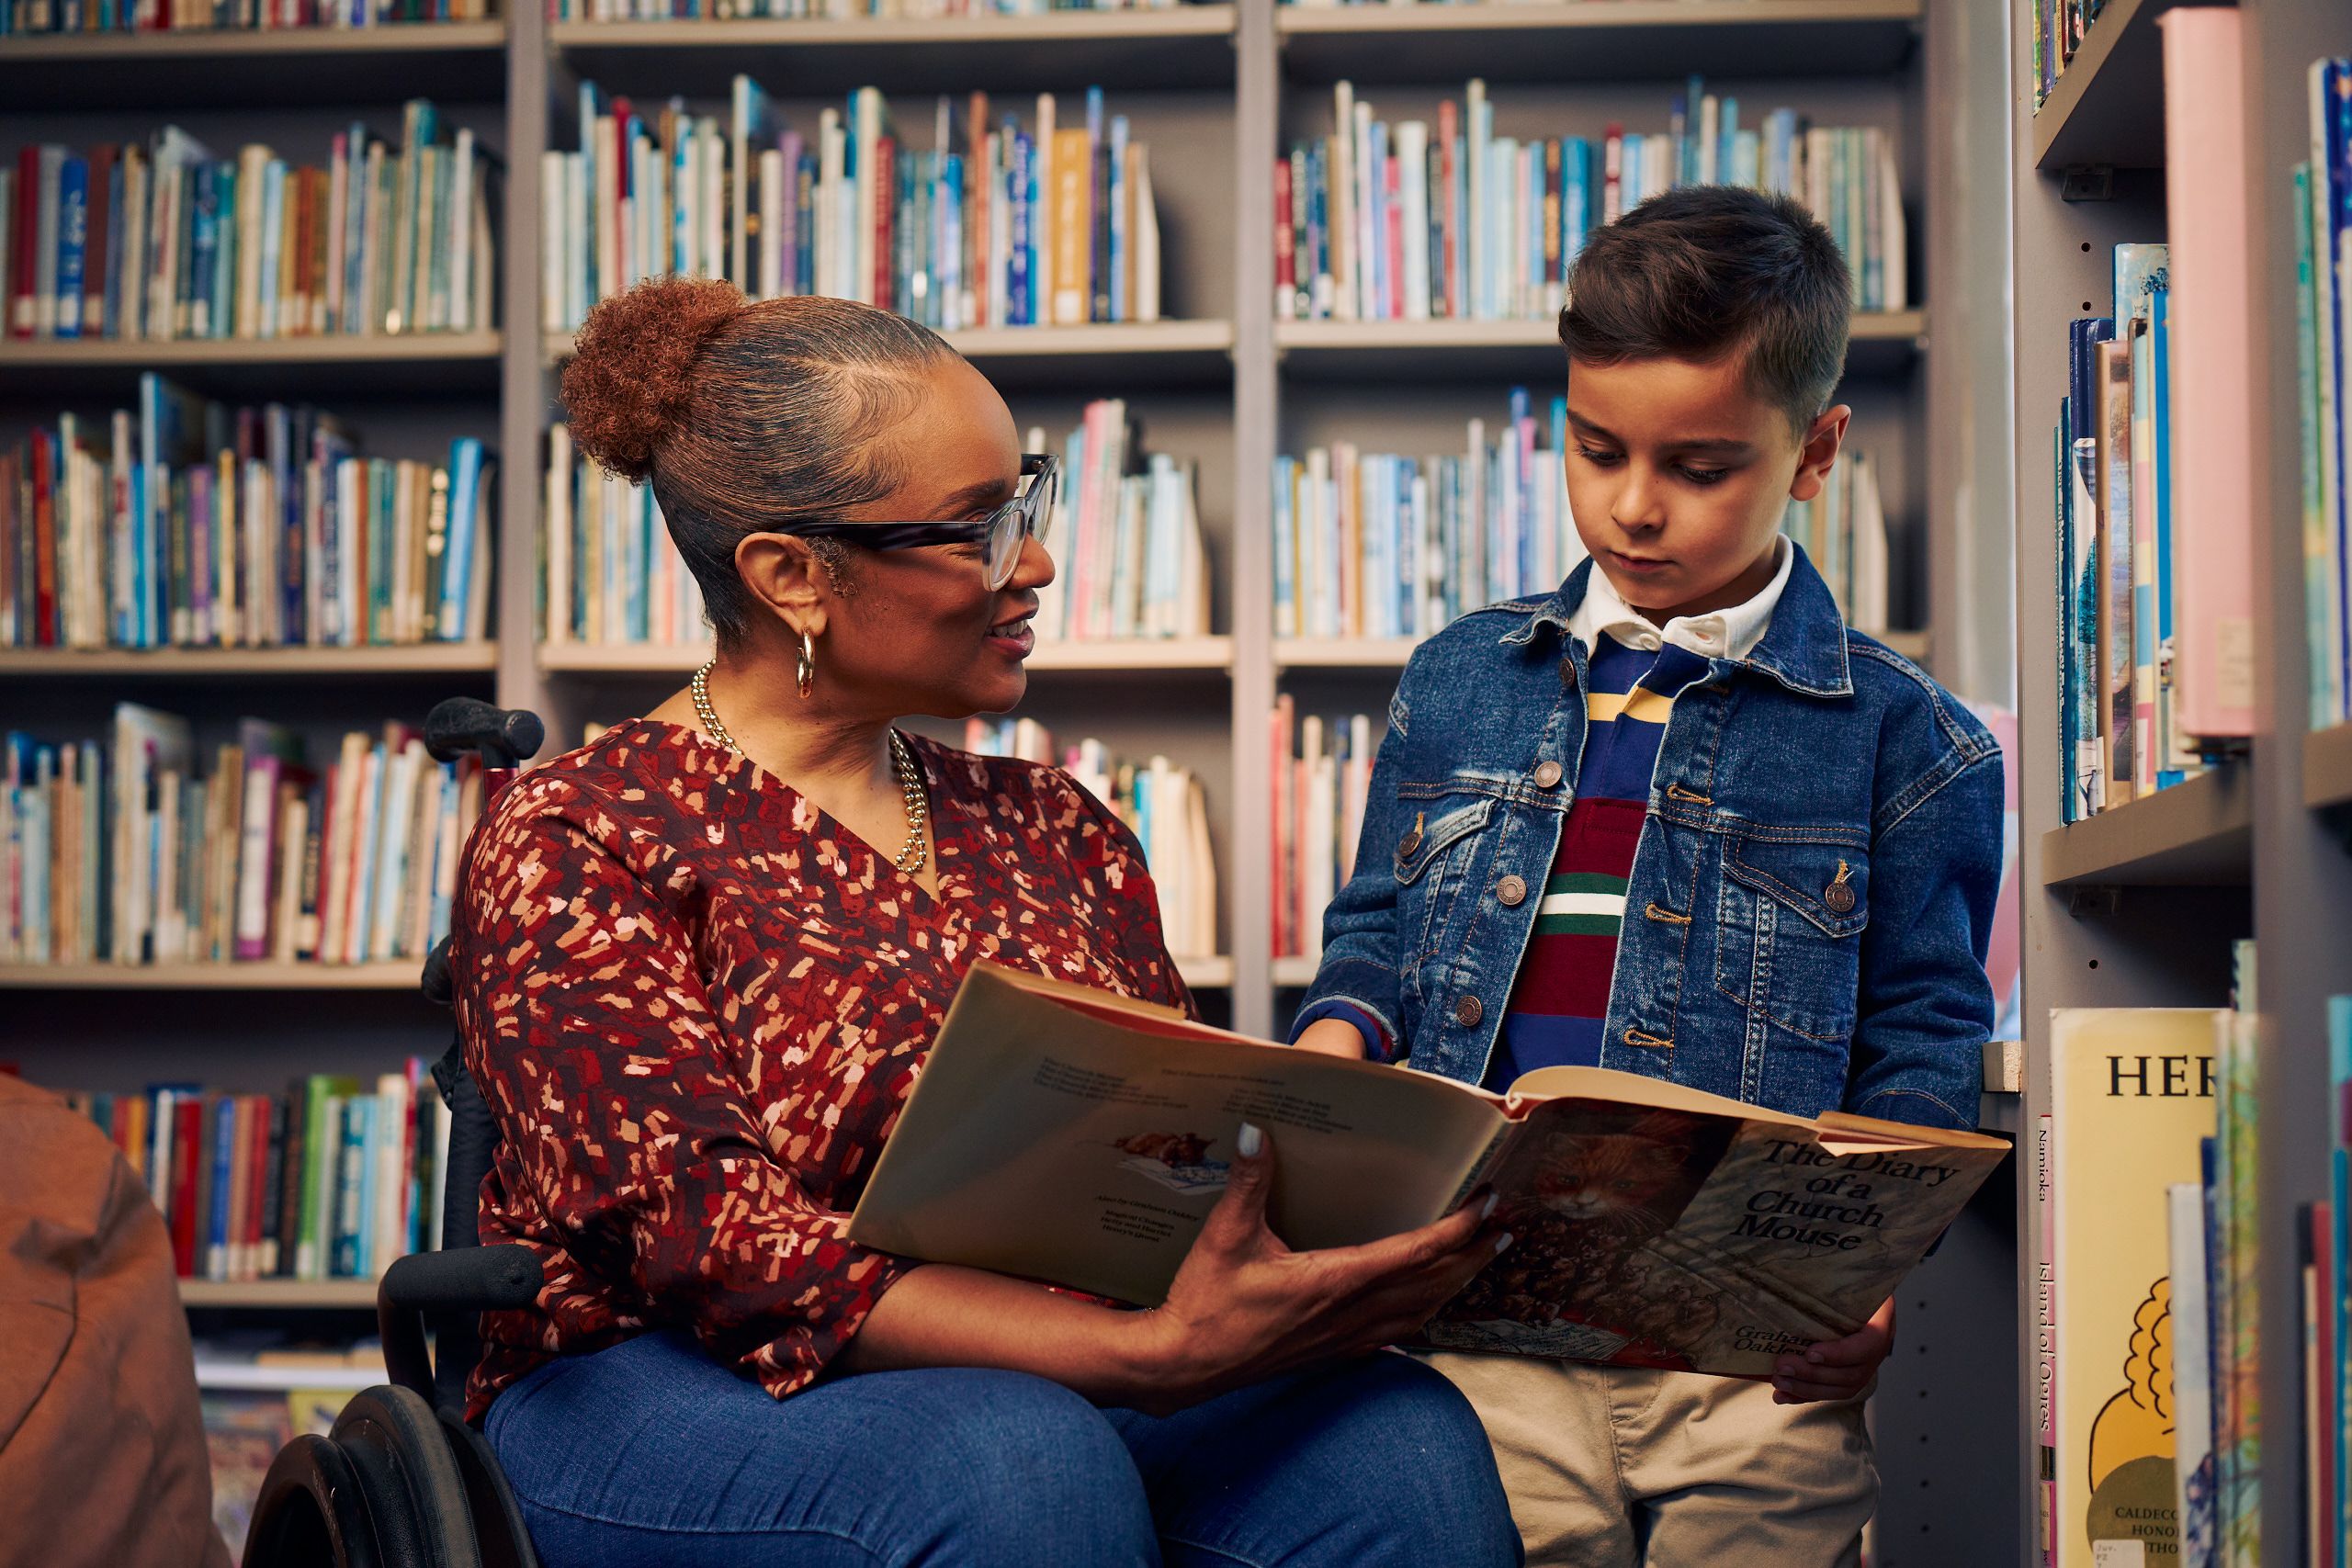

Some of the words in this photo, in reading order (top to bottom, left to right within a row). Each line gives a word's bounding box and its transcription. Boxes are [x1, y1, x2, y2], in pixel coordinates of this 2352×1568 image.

[1763, 1139, 1837, 1167] The
[1841, 1152, 1961, 1188] Diary
[2039, 1130, 2050, 1201] Namioka
[1806, 1174, 1856, 1196] of
[1847, 1183, 1871, 1200] a
[1747, 1190, 1884, 1228] Church
[1730, 1213, 1861, 1250] Mouse
[2040, 1262, 2054, 1325] Island
[2040, 1335, 2054, 1359] of
